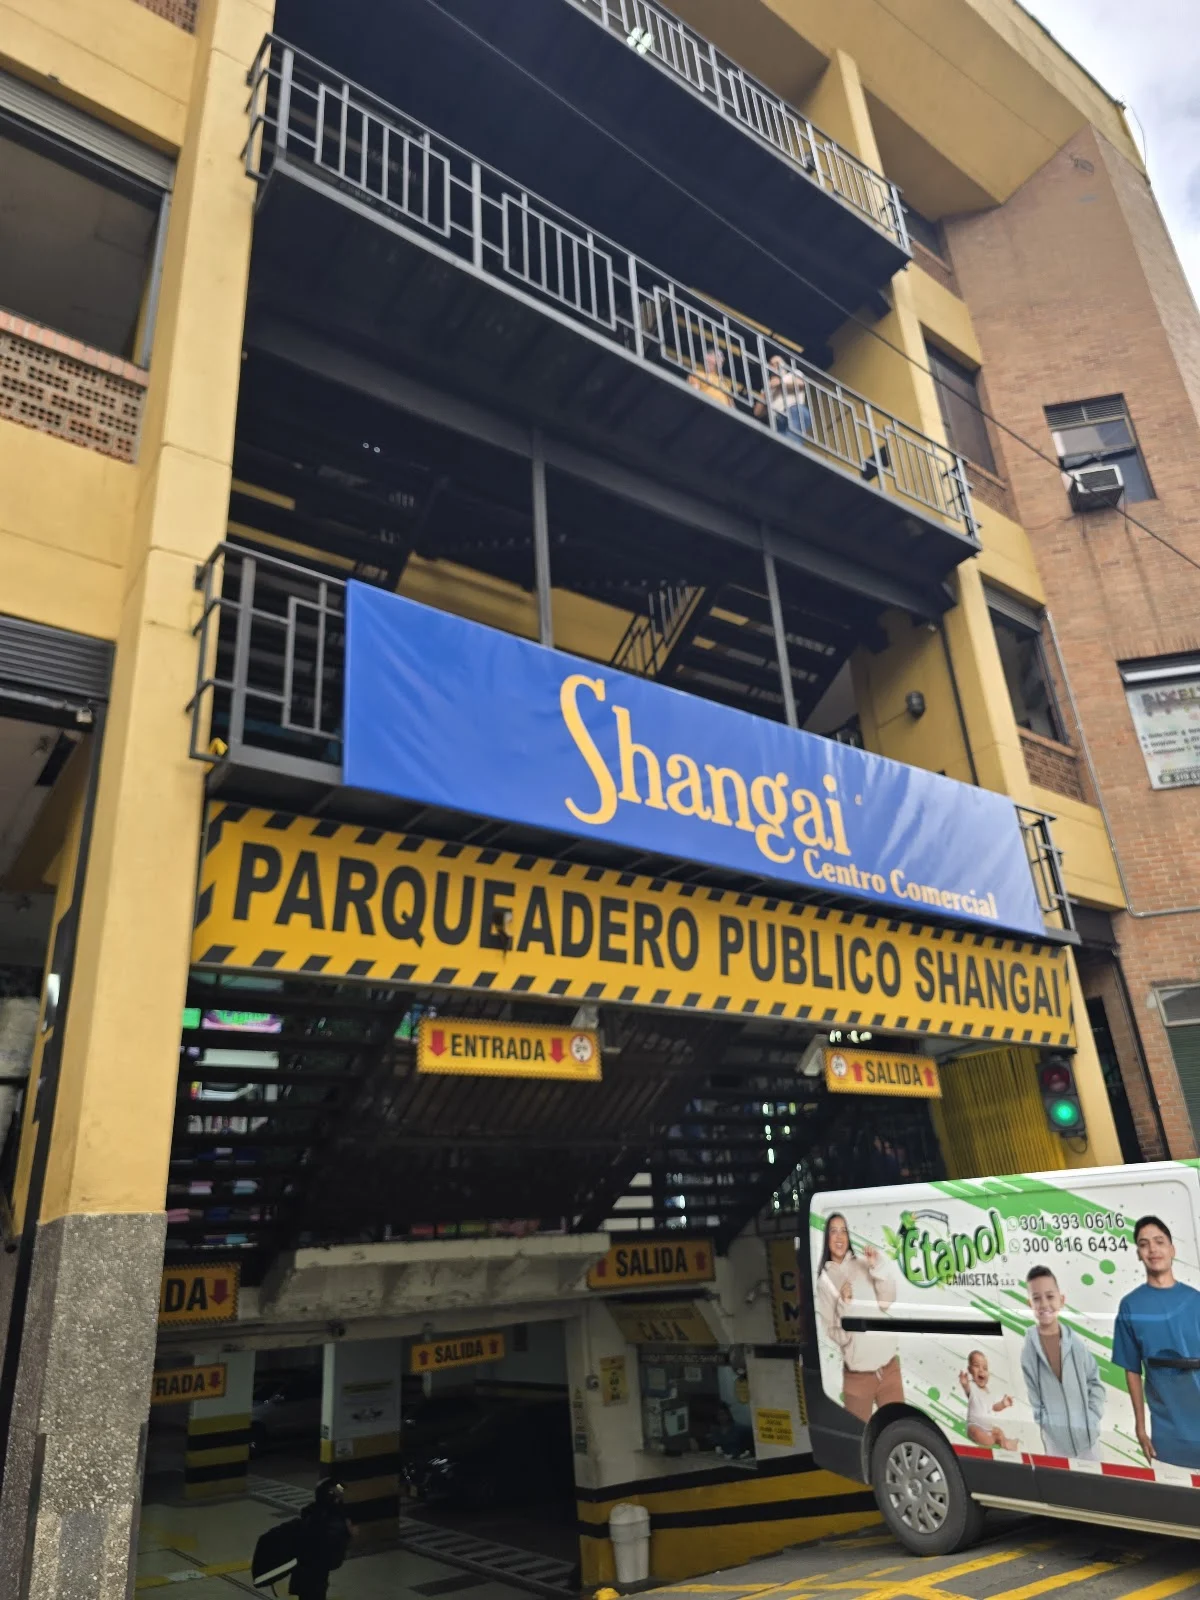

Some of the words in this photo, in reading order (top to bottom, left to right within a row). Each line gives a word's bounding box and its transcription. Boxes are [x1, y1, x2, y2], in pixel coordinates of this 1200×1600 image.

[559, 674, 851, 864] Shangai
[802, 848, 887, 894] Centro
[890, 869, 997, 920] Comercial
[232, 842, 700, 972] PARQUEADERO
[719, 914, 901, 998] PUBLICO
[914, 947, 1063, 1018] SHANGAI
[450, 1033, 546, 1062] ENTRADA
[865, 1060, 923, 1086] SALIDA
[1020, 1215, 1047, 1231] 301
[1052, 1214, 1080, 1230] 393
[1085, 1212, 1125, 1229] 0616
[902, 1209, 1006, 1282] Etanol
[1022, 1237, 1050, 1253] 300
[1054, 1236, 1083, 1252] 816
[1087, 1236, 1128, 1252] 6434
[615, 1246, 688, 1277] SALIDA
[159, 1276, 209, 1312] DA
[946, 1273, 999, 1287] CAMISETAS
[434, 1338, 485, 1364] SALIDA
[153, 1373, 206, 1396] RADA
